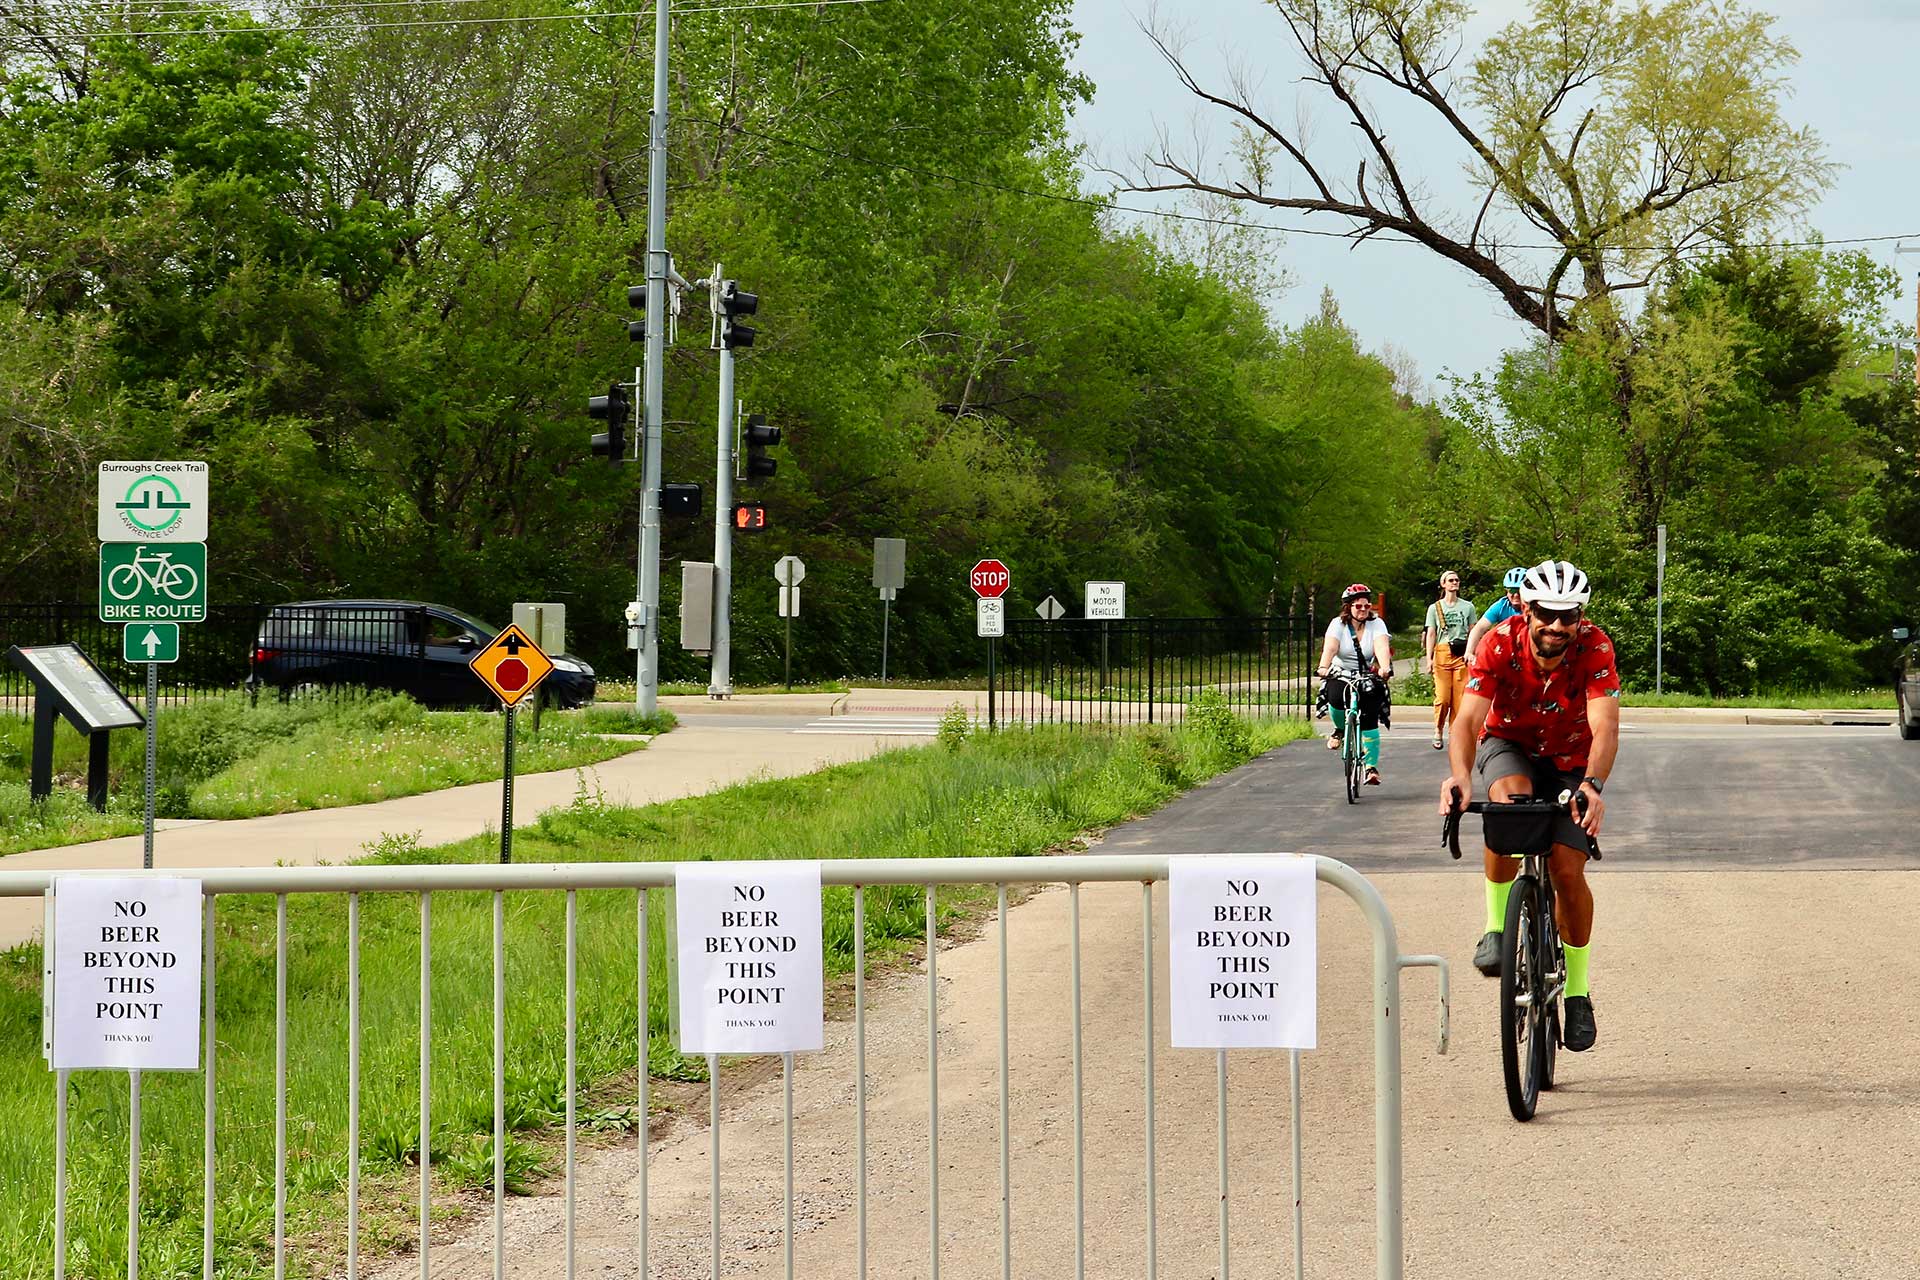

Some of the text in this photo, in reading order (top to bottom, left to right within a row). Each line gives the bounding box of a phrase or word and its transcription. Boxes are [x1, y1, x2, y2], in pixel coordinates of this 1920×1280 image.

[102, 463, 205, 473] Burroughs Creek Trail
[119, 511, 183, 539] LAWRENCE LOOP
[755, 508, 764, 527] 3
[973, 571, 1007, 586] STOP
[1100, 587, 1111, 595] NO
[104, 605, 202, 618] BIKE ROUTE
[1091, 608, 1119, 616] VEHICLES
[734, 885, 765, 901] NO
[1227, 880, 1259, 896] NO
[115, 901, 146, 918] NO
[1214, 906, 1273, 921] BEER
[721, 911, 779, 927] BEER
[102, 927, 160, 943] BEER
[1197, 932, 1291, 947] BEYOND
[705, 937, 797, 952] BEYOND
[84, 952, 177, 968] BEYOND
[1217, 957, 1270, 973] THIS
[725, 962, 776, 978] THIS
[104, 977, 155, 994] THIS
[1210, 983, 1279, 998] POINT
[718, 988, 785, 1004] POINT
[96, 1003, 163, 1020] POINT
[1218, 1014, 1270, 1022] THANK YOU
